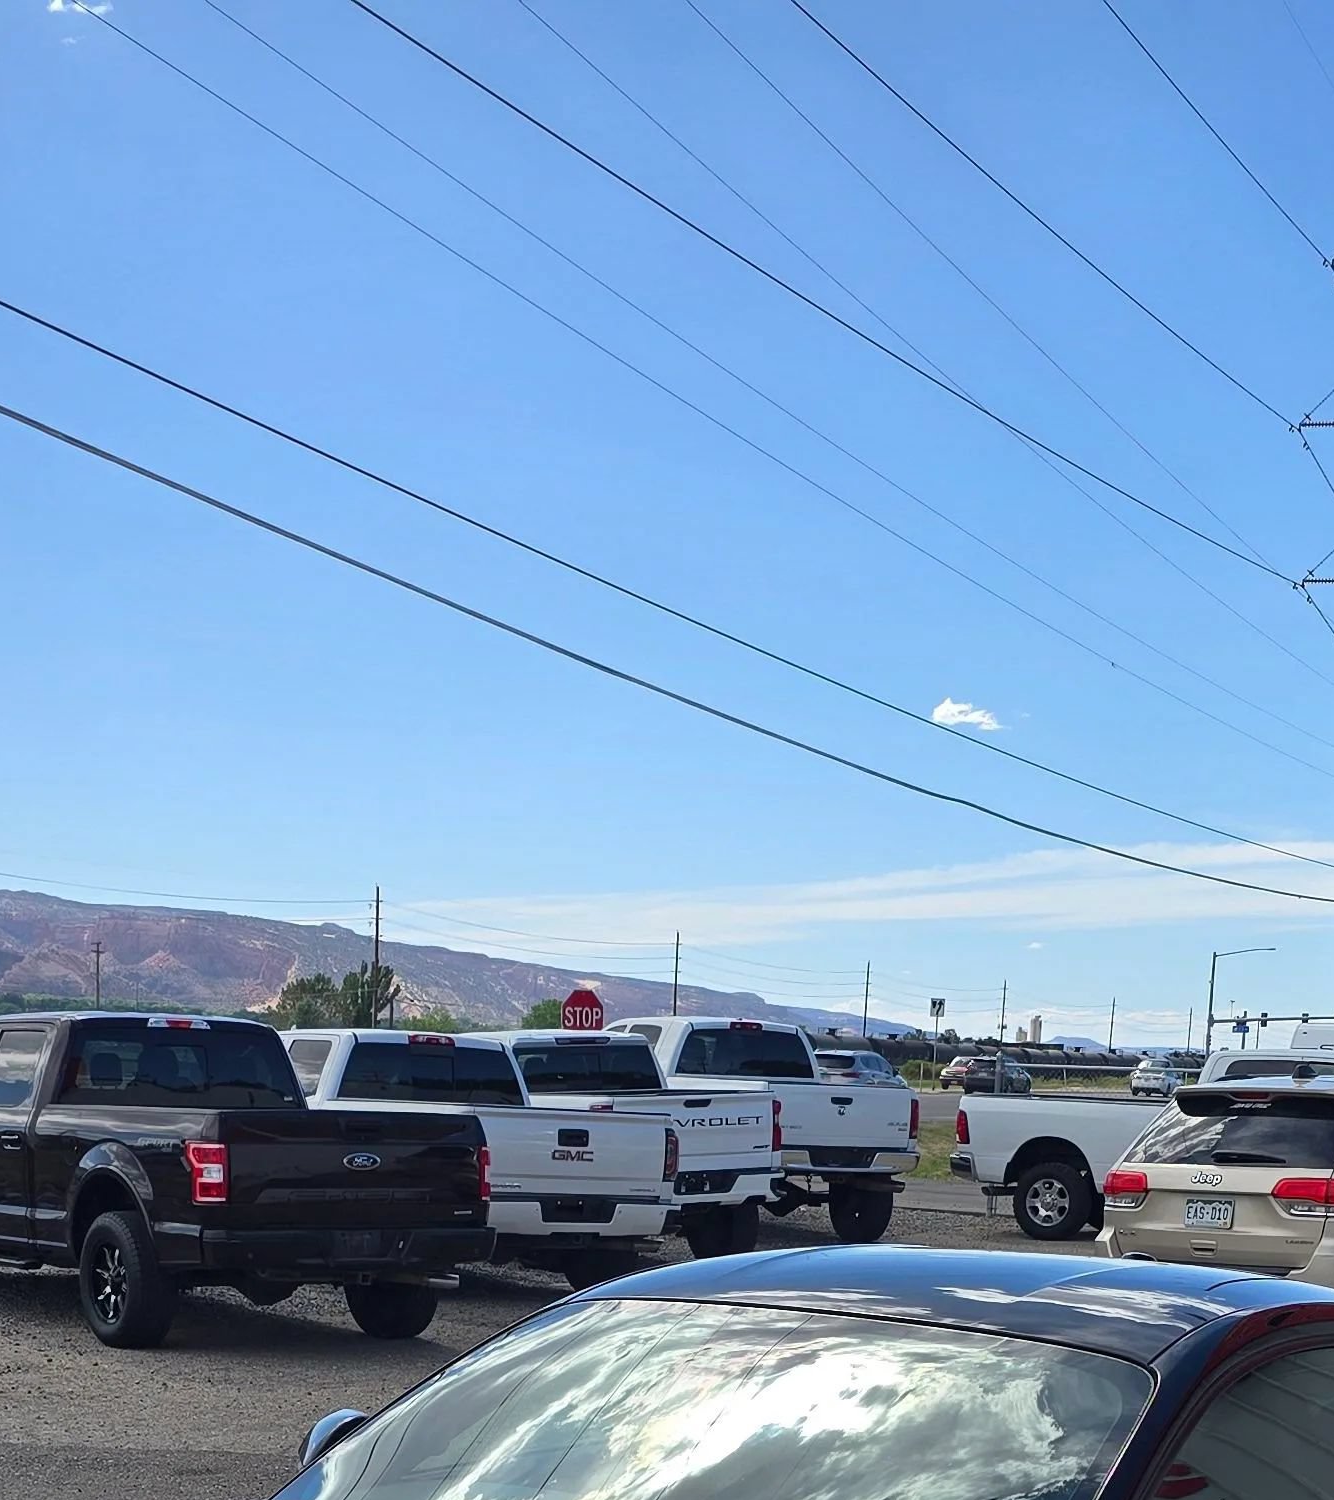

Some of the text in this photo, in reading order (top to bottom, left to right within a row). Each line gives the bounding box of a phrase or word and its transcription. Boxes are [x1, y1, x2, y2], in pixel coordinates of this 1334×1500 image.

[564, 1006, 602, 1028] STOP
[551, 1150, 594, 1162] GMC
[1190, 1171, 1223, 1187] Jeep
